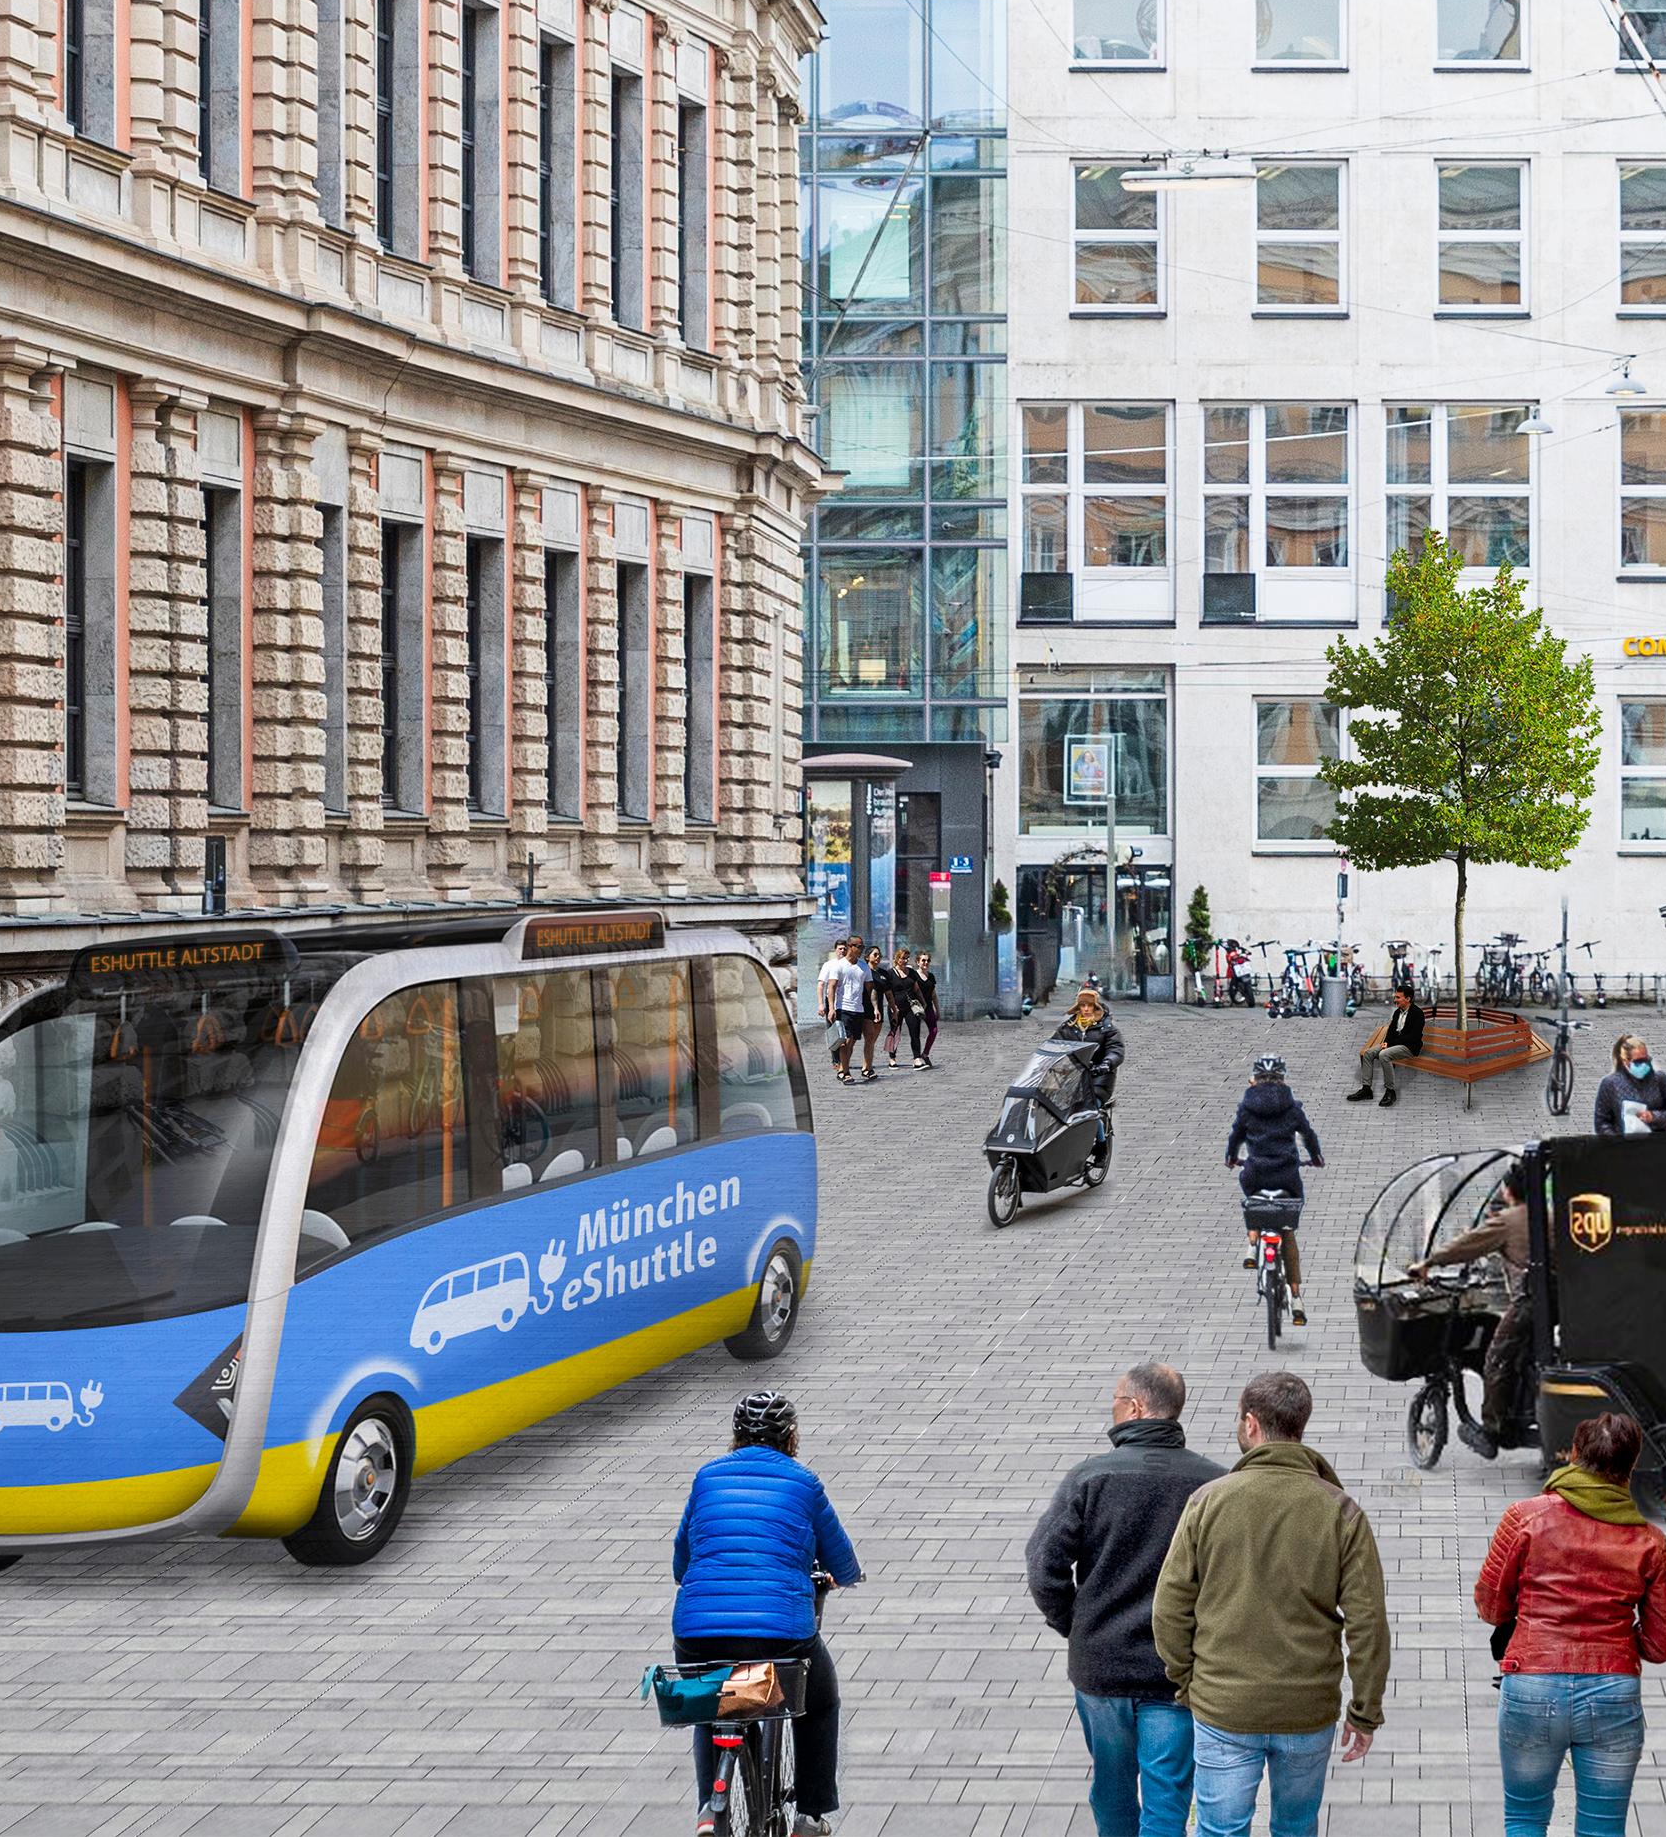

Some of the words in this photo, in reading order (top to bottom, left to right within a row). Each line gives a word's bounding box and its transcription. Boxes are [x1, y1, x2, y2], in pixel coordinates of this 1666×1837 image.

[90, 950, 176, 974] ESHUTTLE
[180, 943, 265, 966] ALTSTADT
[536, 925, 595, 948] ESHUTTLE
[596, 922, 653, 943] ALTSTADT
[576, 1176, 741, 1256] München
[561, 1230, 718, 1312] eShuttle
